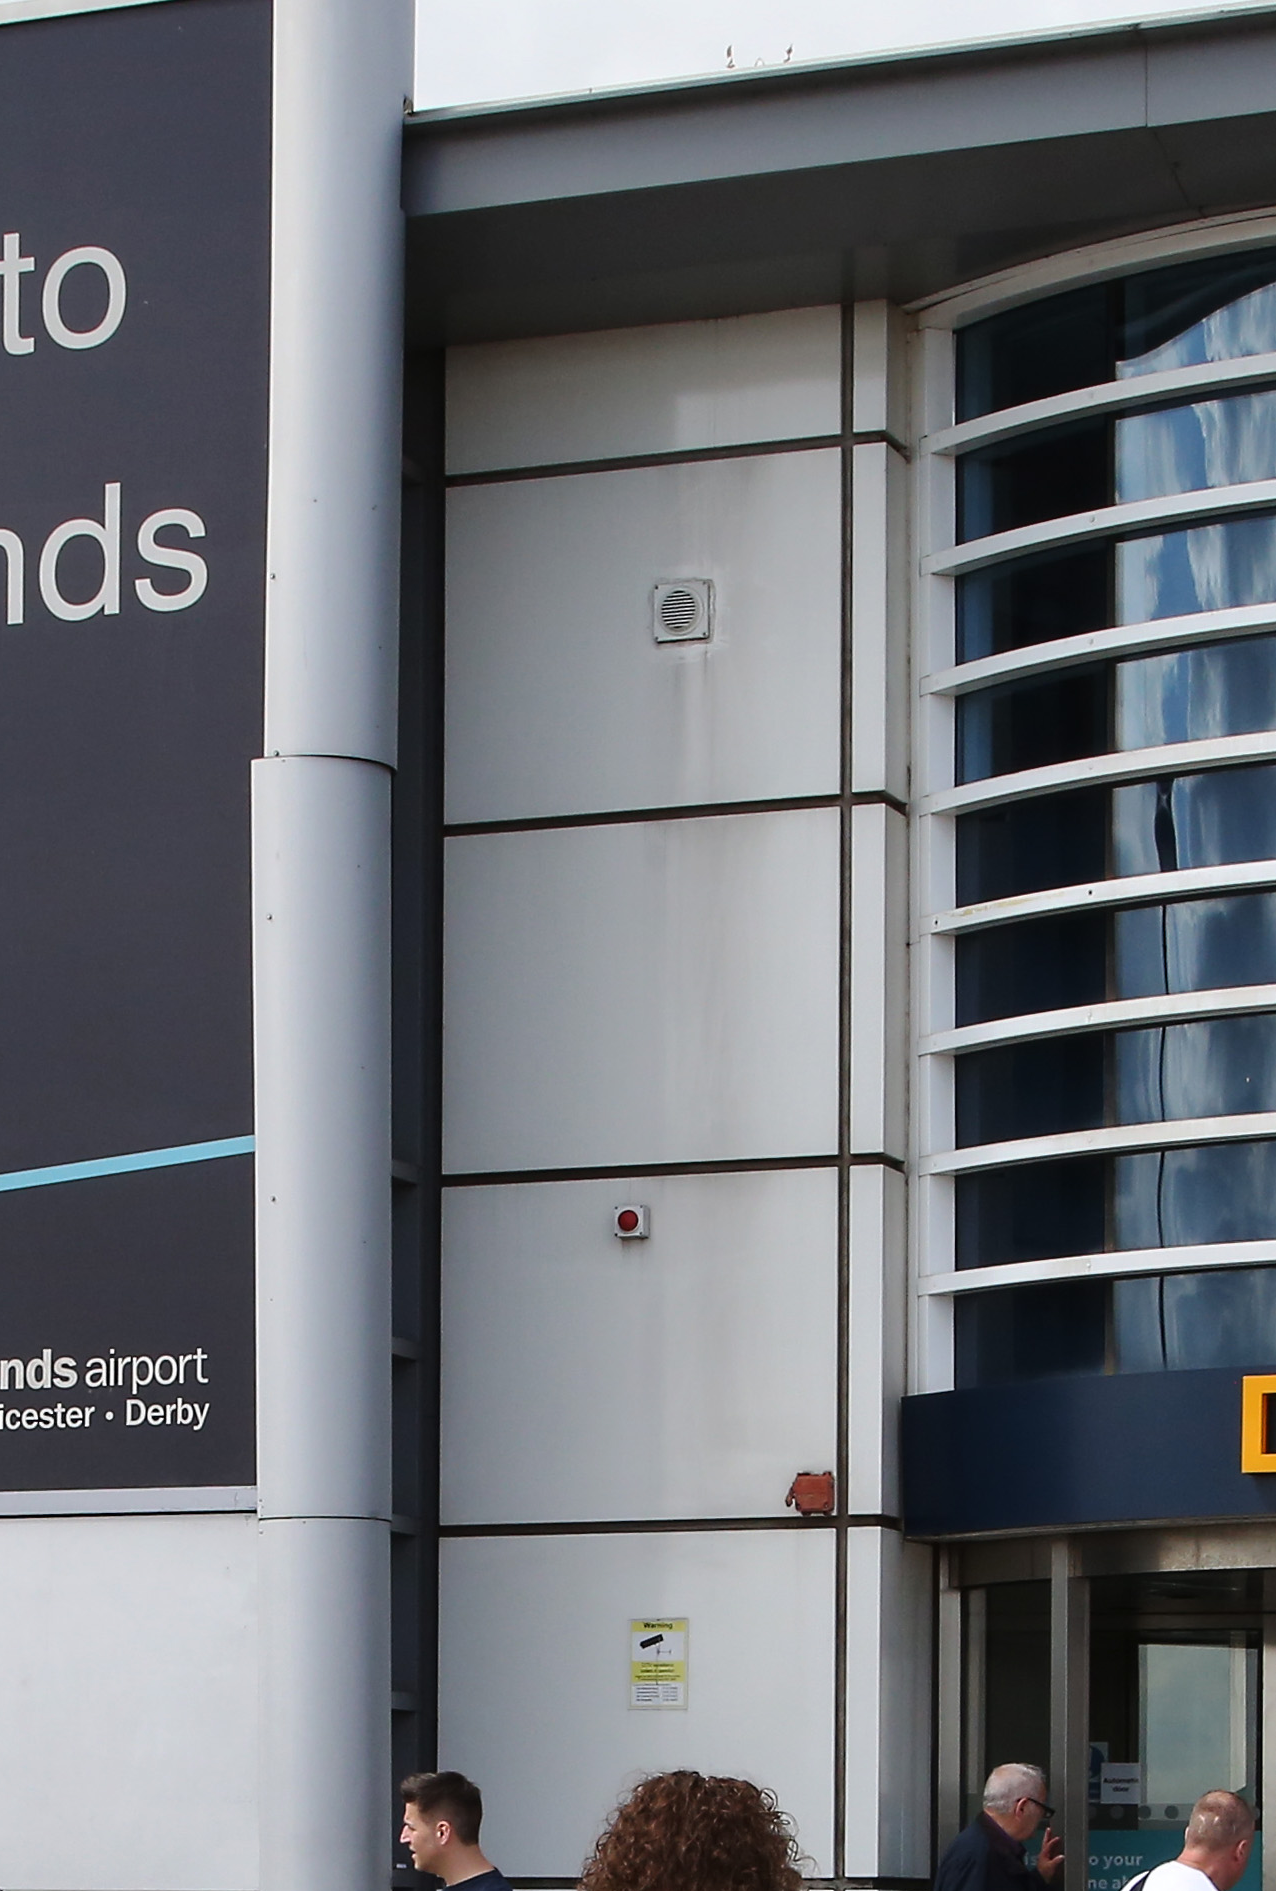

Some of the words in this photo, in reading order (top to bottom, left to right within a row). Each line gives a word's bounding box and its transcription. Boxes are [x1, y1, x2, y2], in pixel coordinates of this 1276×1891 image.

[84, 1347, 210, 1394] airport
[126, 1397, 211, 1431] Derby
[643, 1622, 673, 1630] Warning
[1103, 1855, 1143, 1869] your
[1088, 1878, 1108, 1889] ne
